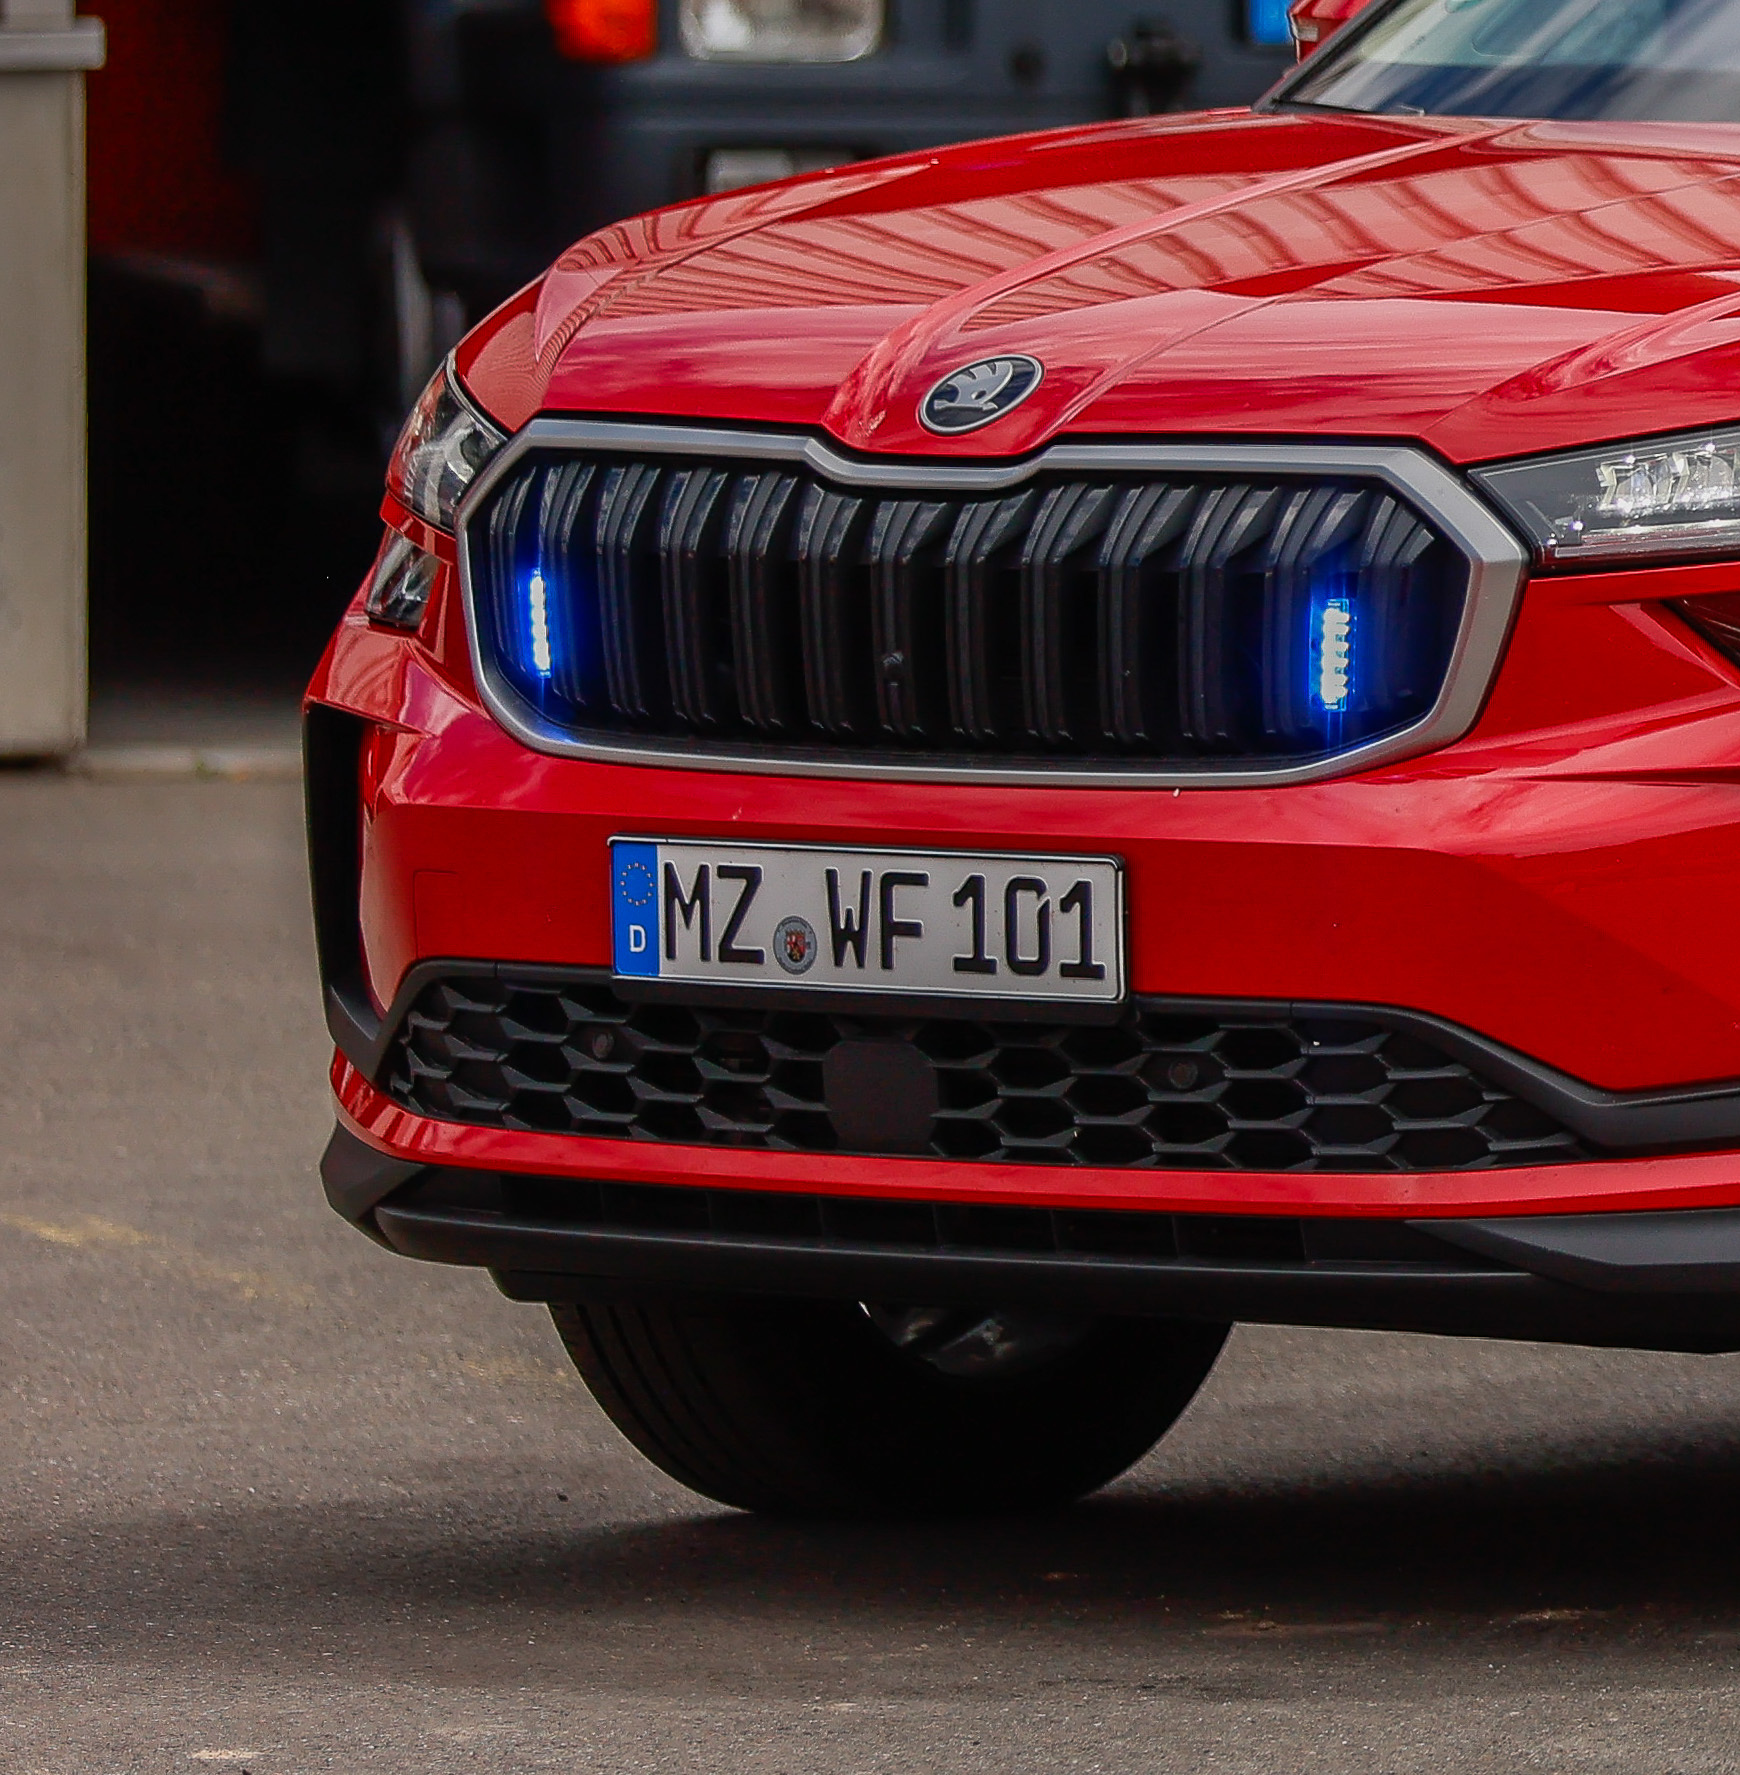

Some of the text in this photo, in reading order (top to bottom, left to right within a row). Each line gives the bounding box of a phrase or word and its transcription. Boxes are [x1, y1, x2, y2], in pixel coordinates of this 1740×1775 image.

[629, 925, 646, 952] D
[664, 862, 765, 964] MZ
[825, 867, 930, 969] WF
[952, 874, 1105, 980] 101
